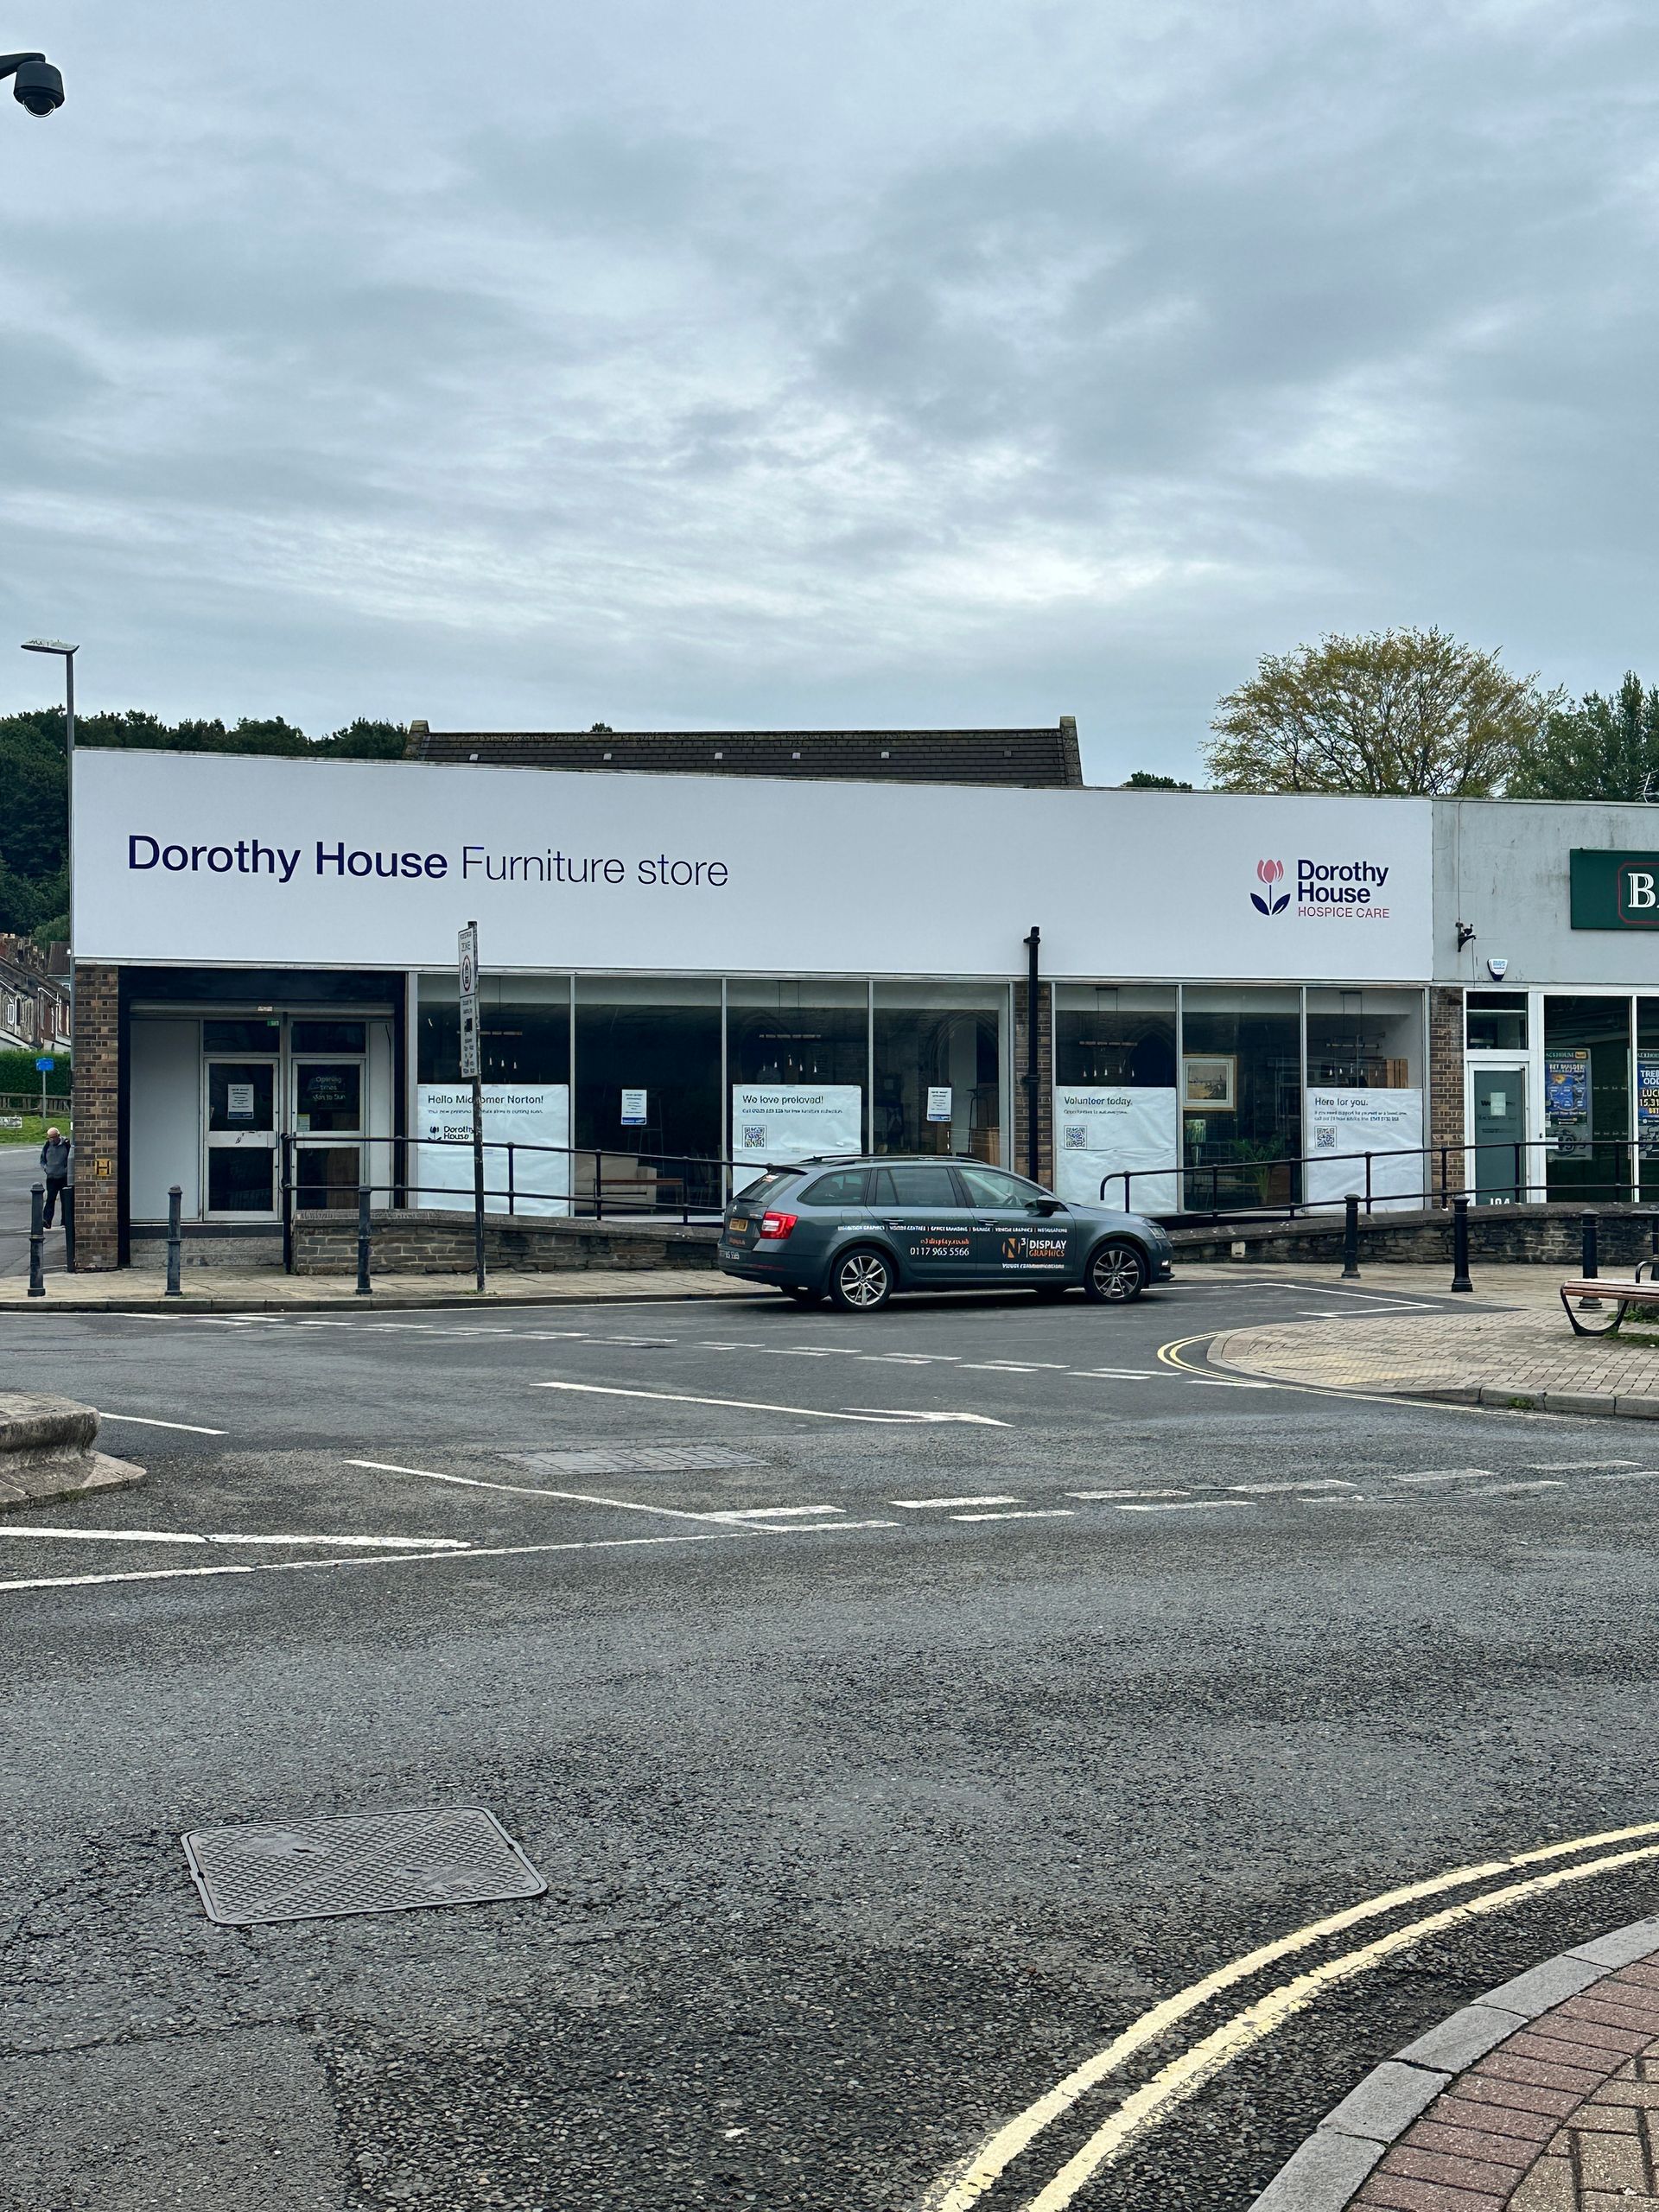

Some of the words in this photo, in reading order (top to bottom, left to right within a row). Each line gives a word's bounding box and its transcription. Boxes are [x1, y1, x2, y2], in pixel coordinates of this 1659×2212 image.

[129, 835, 302, 883] Dorothy
[315, 841, 448, 879] House
[462, 846, 625, 884] Furniture
[638, 854, 728, 887] store
[1297, 859, 1389, 887] Dorothy
[1297, 880, 1371, 904] House
[1628, 873, 1659, 908] B
[1298, 907, 1353, 918] HOSPICE
[1356, 908, 1390, 918] CARE
[1642, 1089, 1659, 1097] LUC
[428, 1095, 453, 1104] Hello
[455, 1095, 505, 1104] Midomer
[507, 1095, 543, 1104] Norton!
[742, 1095, 758, 1104] We
[760, 1095, 779, 1104] love
[781, 1095, 823, 1106] preloved!
[1065, 1096, 1105, 1105] Volunteer
[1107, 1096, 1134, 1107] today.
[1314, 1097, 1335, 1106] Here
[1337, 1097, 1349, 1106] for
[1351, 1099, 1369, 1108] you.
[443, 1125, 474, 1135] Dorothy
[96, 1160, 110, 1175] H
[1028, 1240, 1067, 1249] DISPLAY
[910, 1247, 931, 1255] 0117
[932, 1247, 948, 1256] 965
[949, 1247, 969, 1256] 5566
